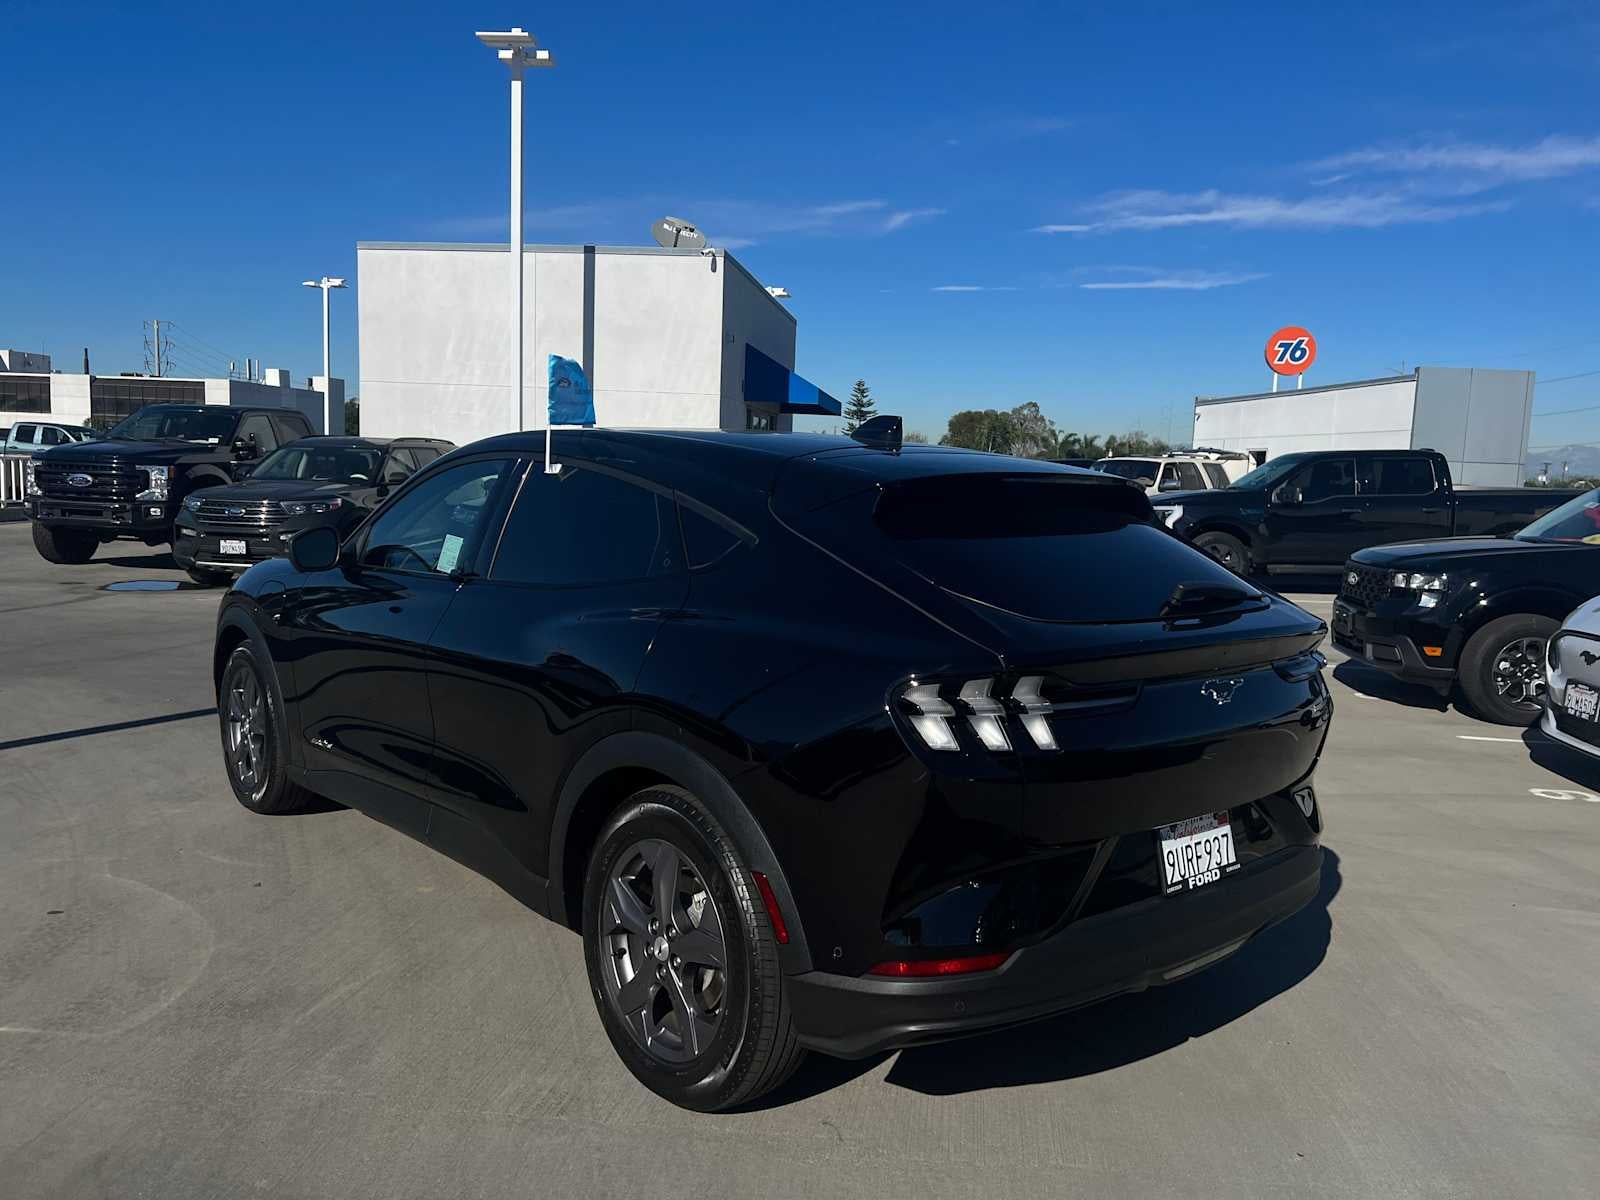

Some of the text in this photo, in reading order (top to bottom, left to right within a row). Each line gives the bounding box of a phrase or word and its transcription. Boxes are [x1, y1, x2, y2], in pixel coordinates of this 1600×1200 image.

[1273, 337, 1309, 364] 76
[1166, 833, 1230, 883] 9URF937
[1188, 869, 1221, 889] FORD
